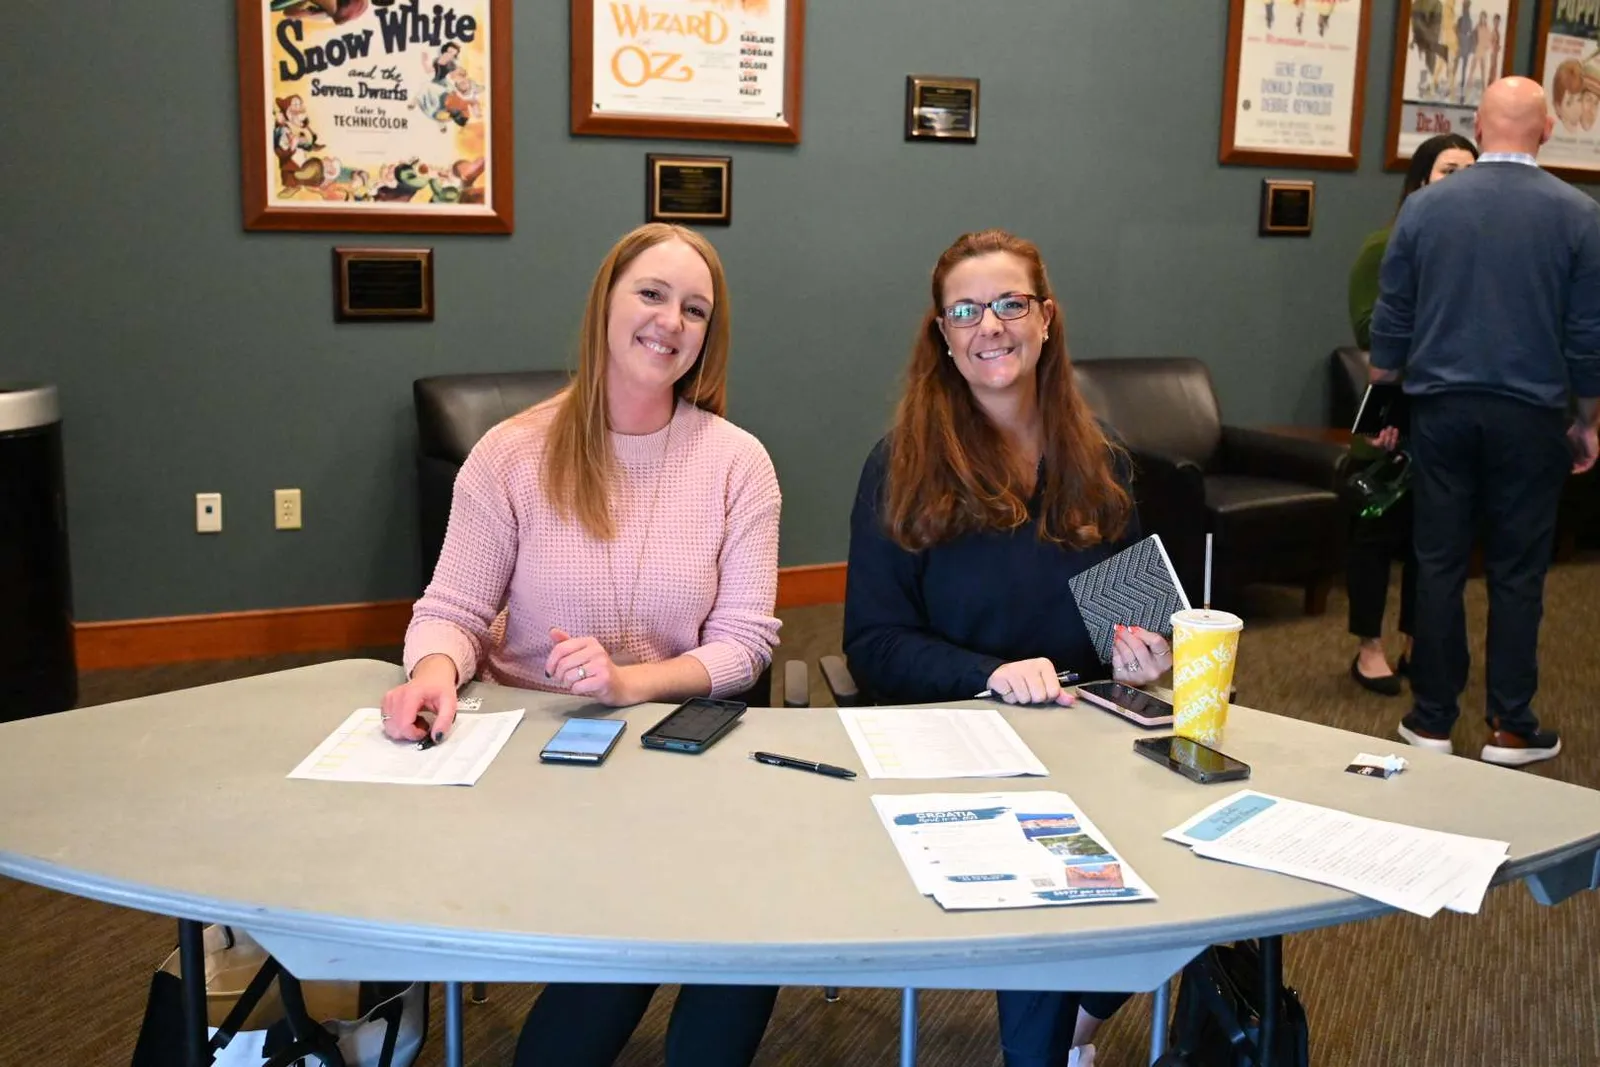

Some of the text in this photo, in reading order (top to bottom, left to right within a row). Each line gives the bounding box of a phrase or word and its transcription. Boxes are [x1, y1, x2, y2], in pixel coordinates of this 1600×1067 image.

[610, 3, 729, 45] WIZARD
[276, 0, 477, 82] Snow White
[348, 66, 403, 82] and the
[311, 79, 409, 101] Seven Dwarfs
[334, 115, 409, 130] TECHNICOLOR
[915, 811, 978, 819] CROATIA
